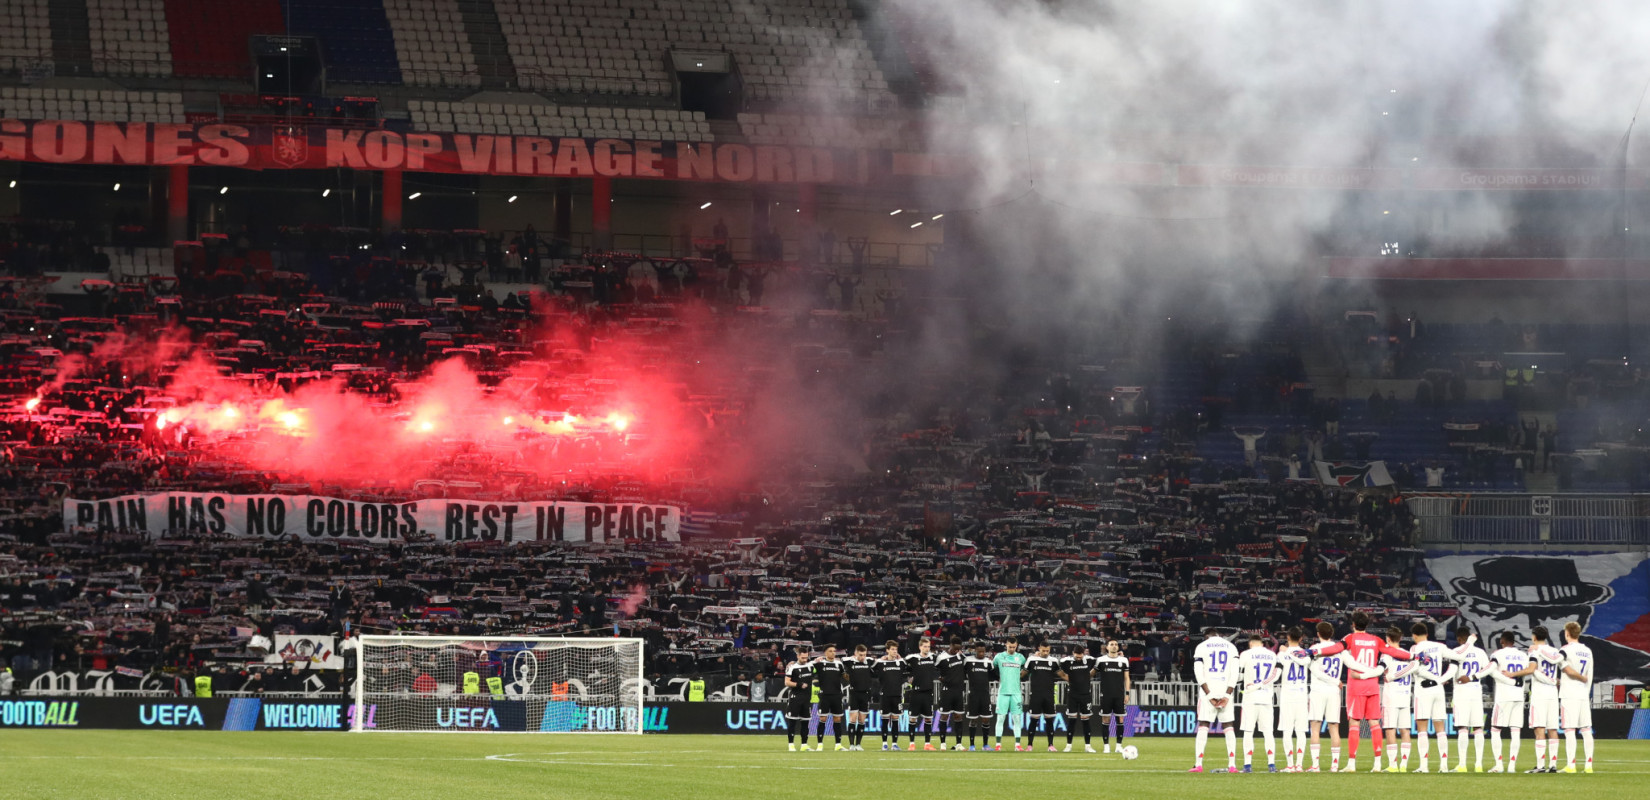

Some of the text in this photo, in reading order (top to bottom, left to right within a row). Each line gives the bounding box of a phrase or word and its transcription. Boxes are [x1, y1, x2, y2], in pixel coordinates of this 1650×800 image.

[326, 129, 833, 183] KOP VIRAGE NORD
[1220, 168, 1298, 184] Groupama
[1460, 171, 1601, 186] Groupama STADIUM
[77, 498, 147, 532] PAIN
[168, 496, 226, 534] HAS
[246, 497, 286, 536] NO
[445, 502, 518, 542] REST
[536, 506, 565, 541] IN
[585, 505, 669, 542] PEACE
[1208, 650, 1228, 673] 19
[1322, 657, 1341, 679] 23
[1356, 648, 1375, 668] 40
[1579, 660, 1588, 675] 7
[1253, 662, 1272, 684] 17
[1287, 662, 1306, 684] 44
[1541, 660, 1556, 679] 39
[139, 704, 205, 726] UEFA
[263, 704, 341, 728] WELCOME
[436, 707, 500, 728] UEFA
[726, 709, 788, 730] UEFA
